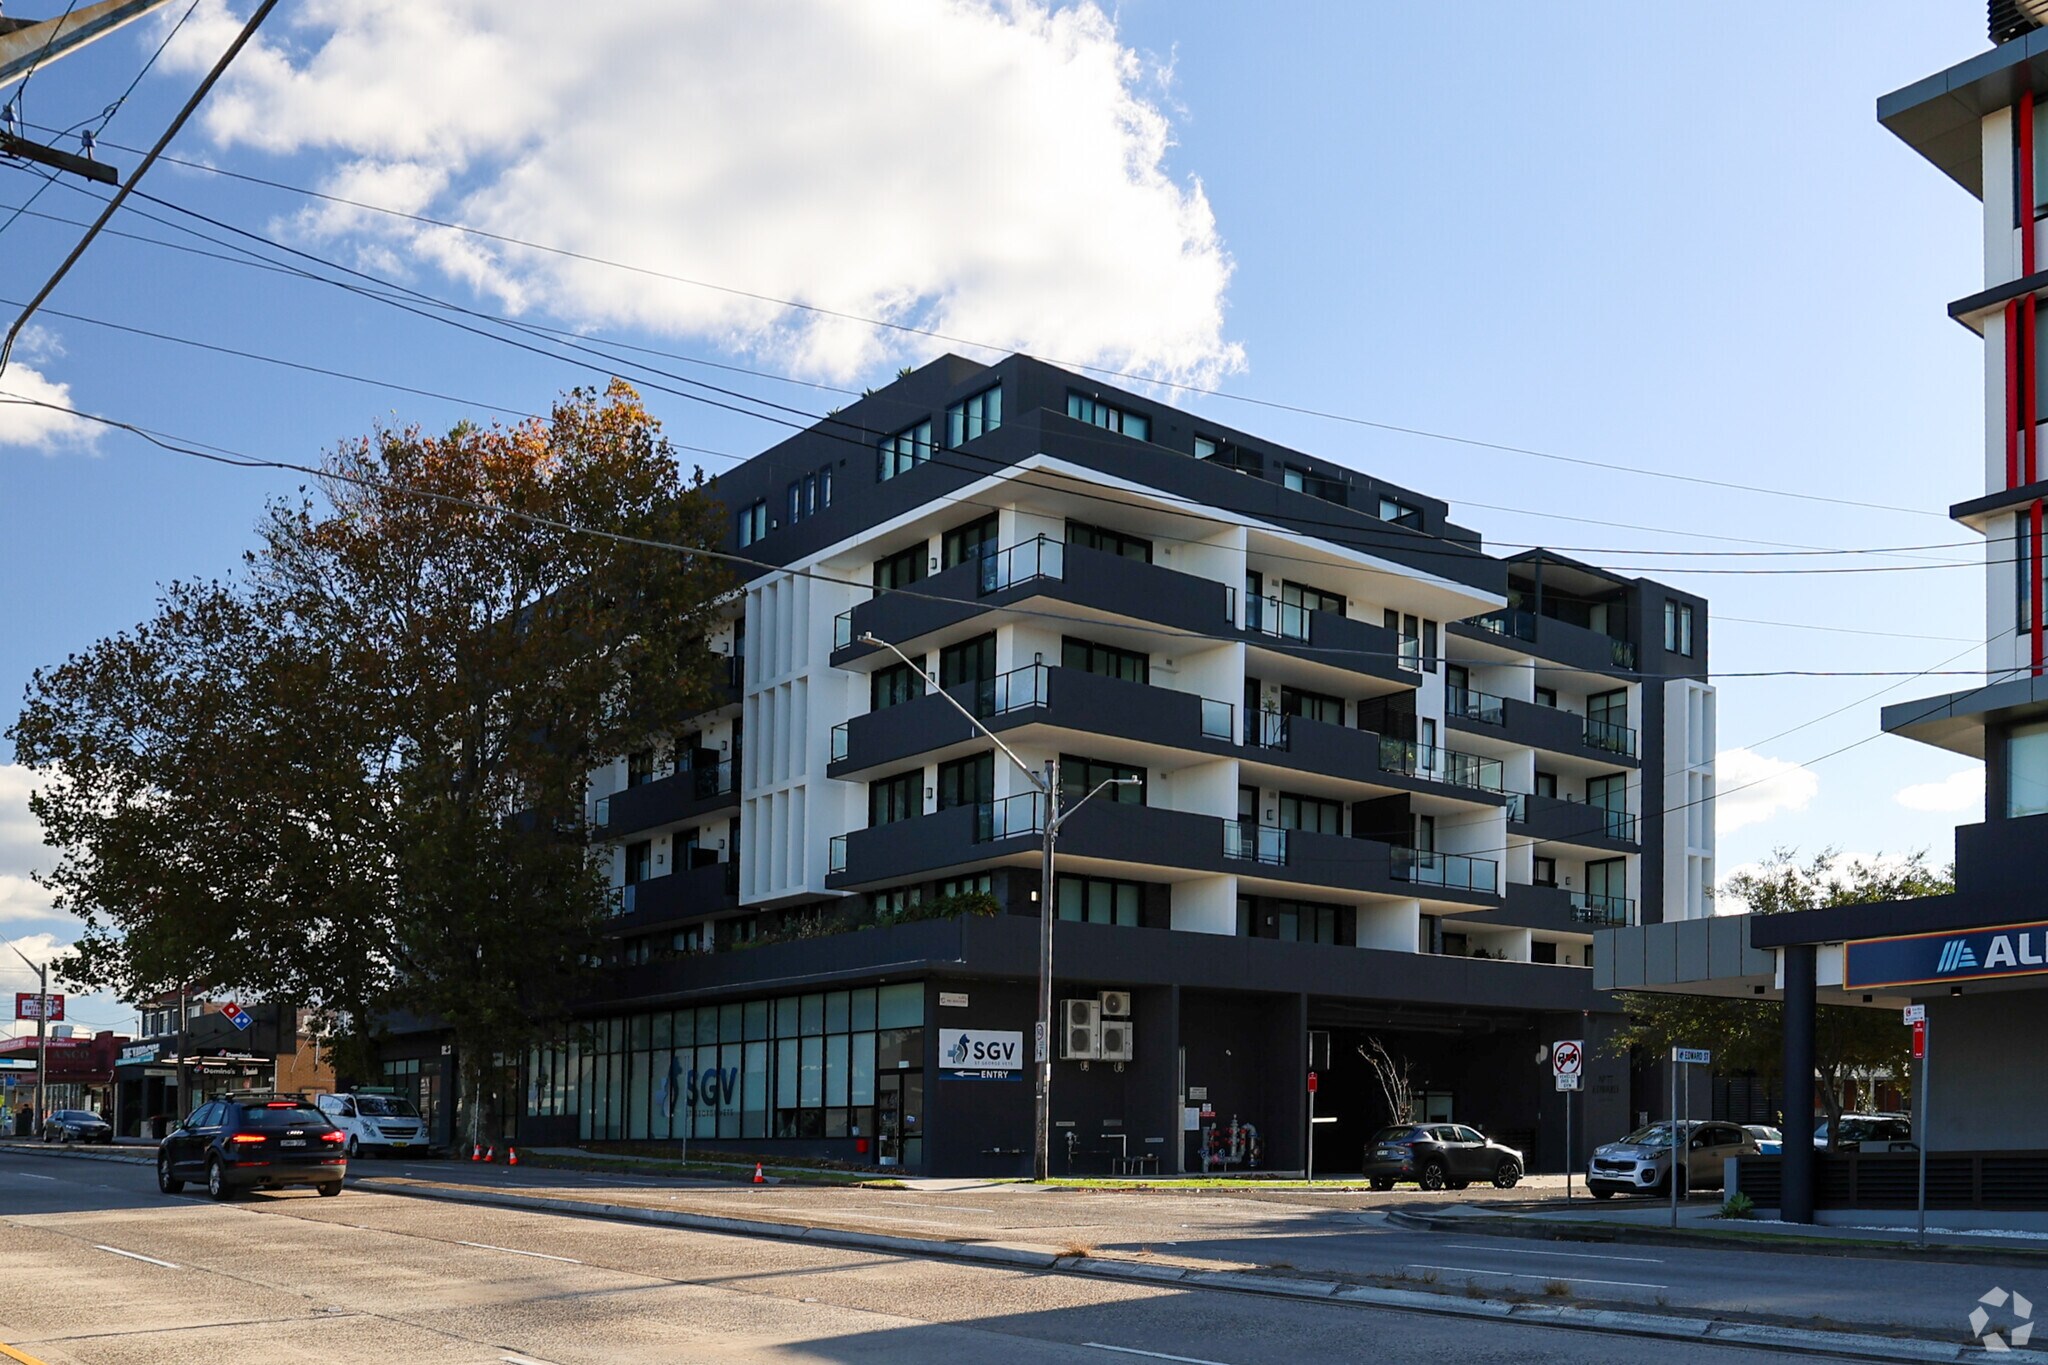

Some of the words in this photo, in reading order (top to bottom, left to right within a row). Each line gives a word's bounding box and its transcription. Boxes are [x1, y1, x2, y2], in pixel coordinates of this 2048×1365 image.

[1984, 931, 2048, 968] AL
[973, 1041, 1015, 1060] SGV
[1685, 1051, 1702, 1060] EDWARD
[1704, 1052, 1709, 1060] ST
[203, 1067, 235, 1075] Domino's
[981, 1071, 1008, 1079] ENTRY
[687, 1067, 738, 1106] SGV
